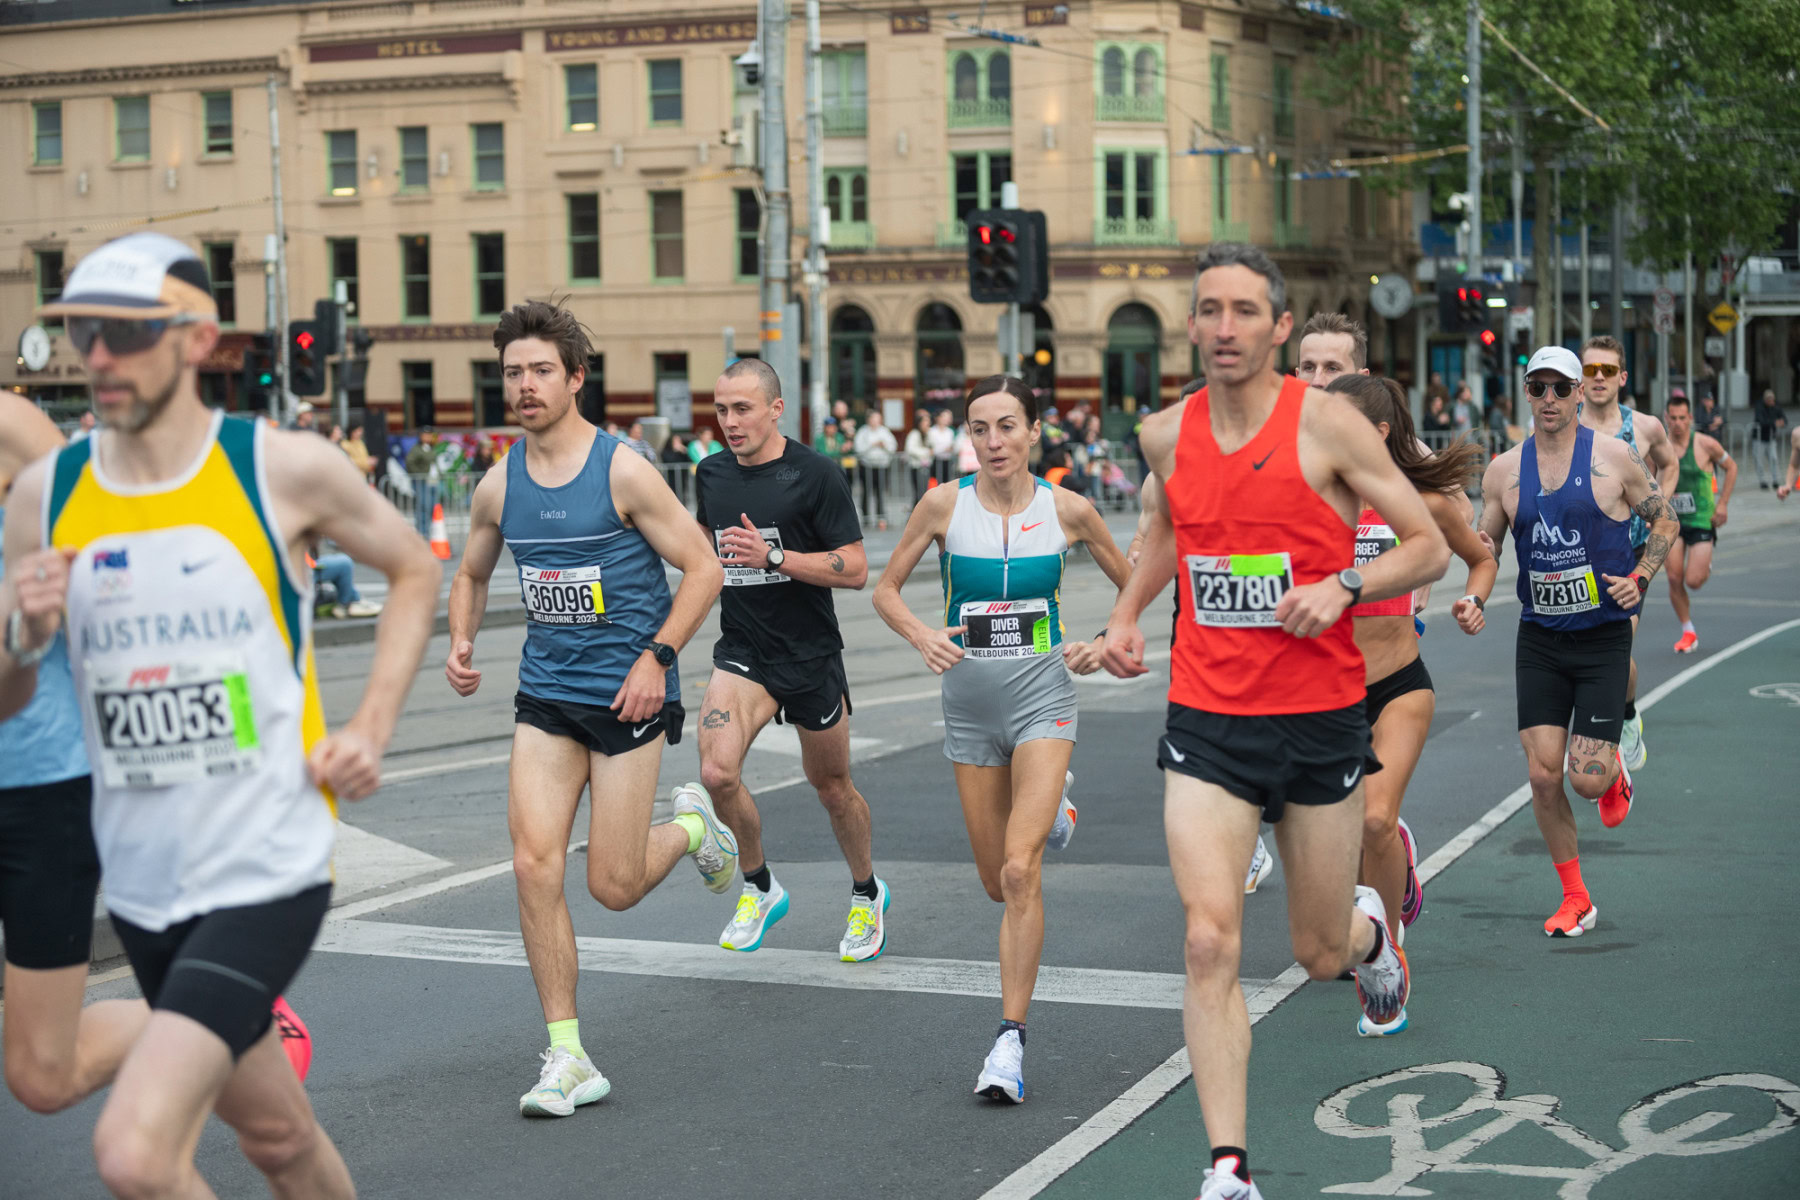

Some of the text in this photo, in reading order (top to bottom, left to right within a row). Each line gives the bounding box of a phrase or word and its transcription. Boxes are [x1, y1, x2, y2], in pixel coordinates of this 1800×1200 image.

[550, 29, 617, 48] YOUNG
[624, 26, 666, 43] AND
[378, 39, 443, 57] HOTEL
[727, 569, 763, 577] MELBOURNE
[529, 584, 595, 613] 36096
[1199, 574, 1283, 610] 23780
[1536, 579, 1589, 606] 27310
[1539, 604, 1573, 614] MELBOURNE
[532, 612, 598, 624] MELBOURNE 2025
[991, 617, 1020, 632] DIVER
[1203, 613, 1256, 624] MELBOURNE
[990, 632, 1022, 646] 20006
[1038, 625, 1048, 651] ELITE
[971, 648, 1020, 658] MELBOURNE
[104, 683, 235, 748] 20053
